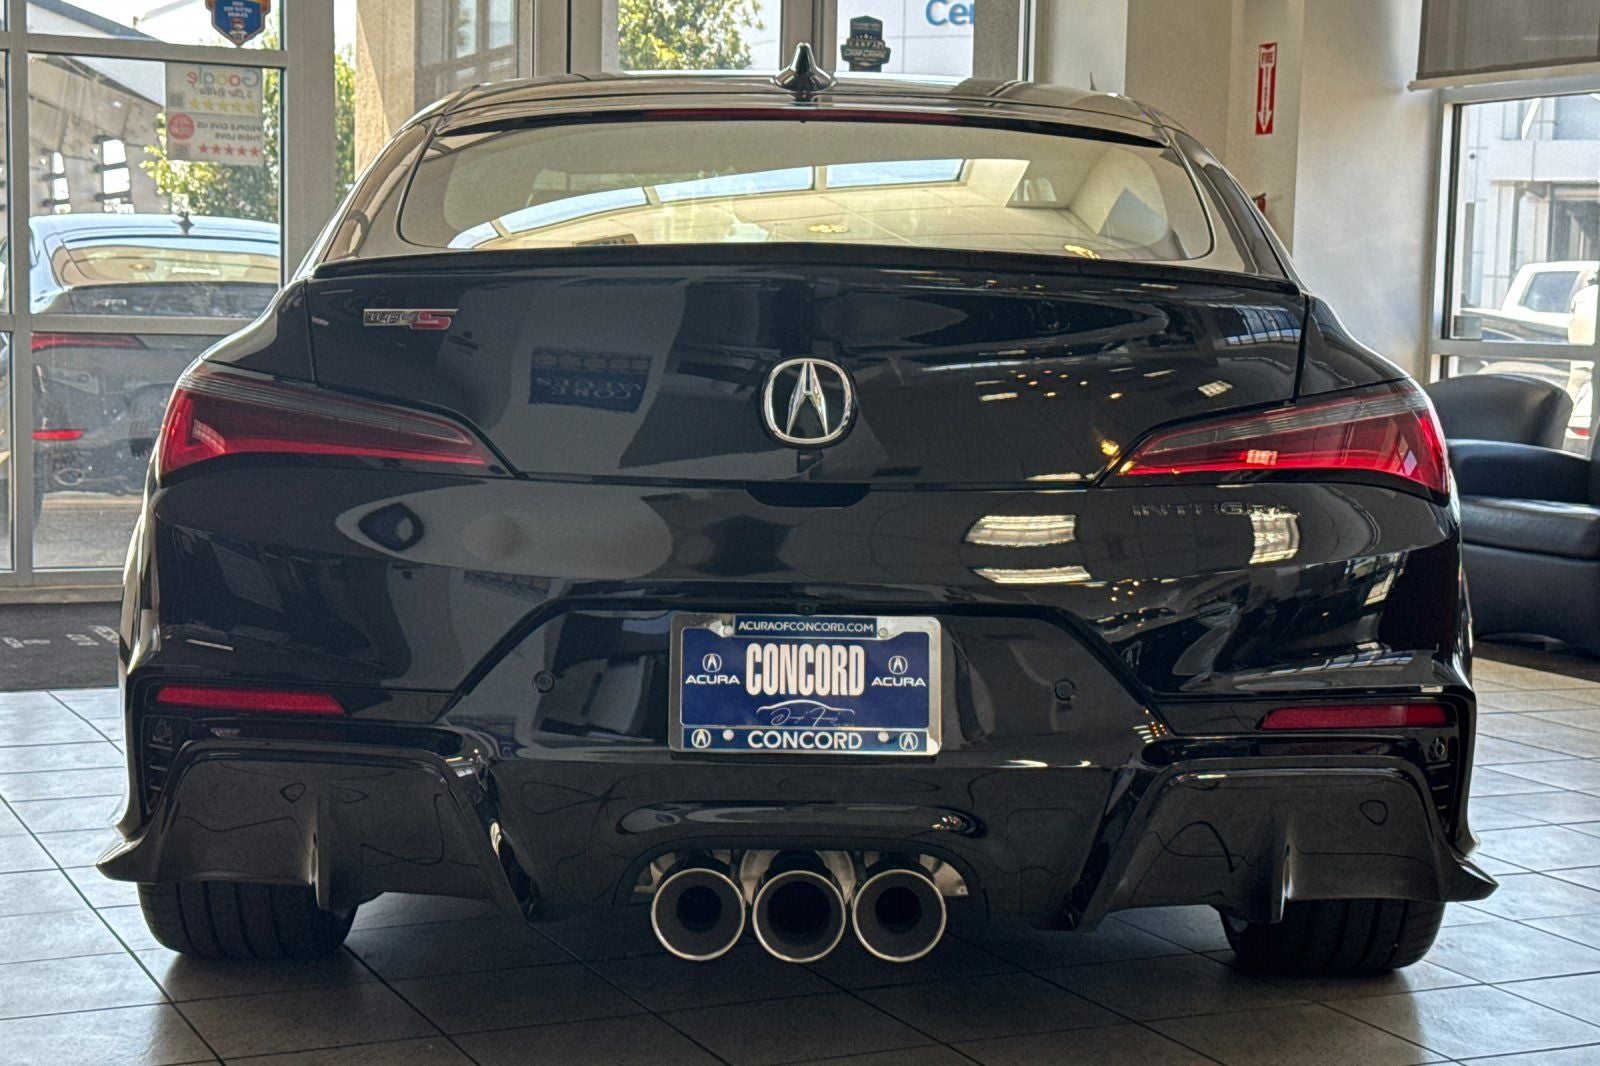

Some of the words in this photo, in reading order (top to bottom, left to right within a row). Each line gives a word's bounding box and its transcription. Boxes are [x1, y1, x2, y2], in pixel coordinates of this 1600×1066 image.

[738, 620, 874, 633] ACURAOFCONCORD.COM
[745, 643, 865, 696] CONCORD
[685, 674, 740, 685] ACURA
[871, 676, 926, 687] ACURA
[747, 730, 863, 749] CONCORD
